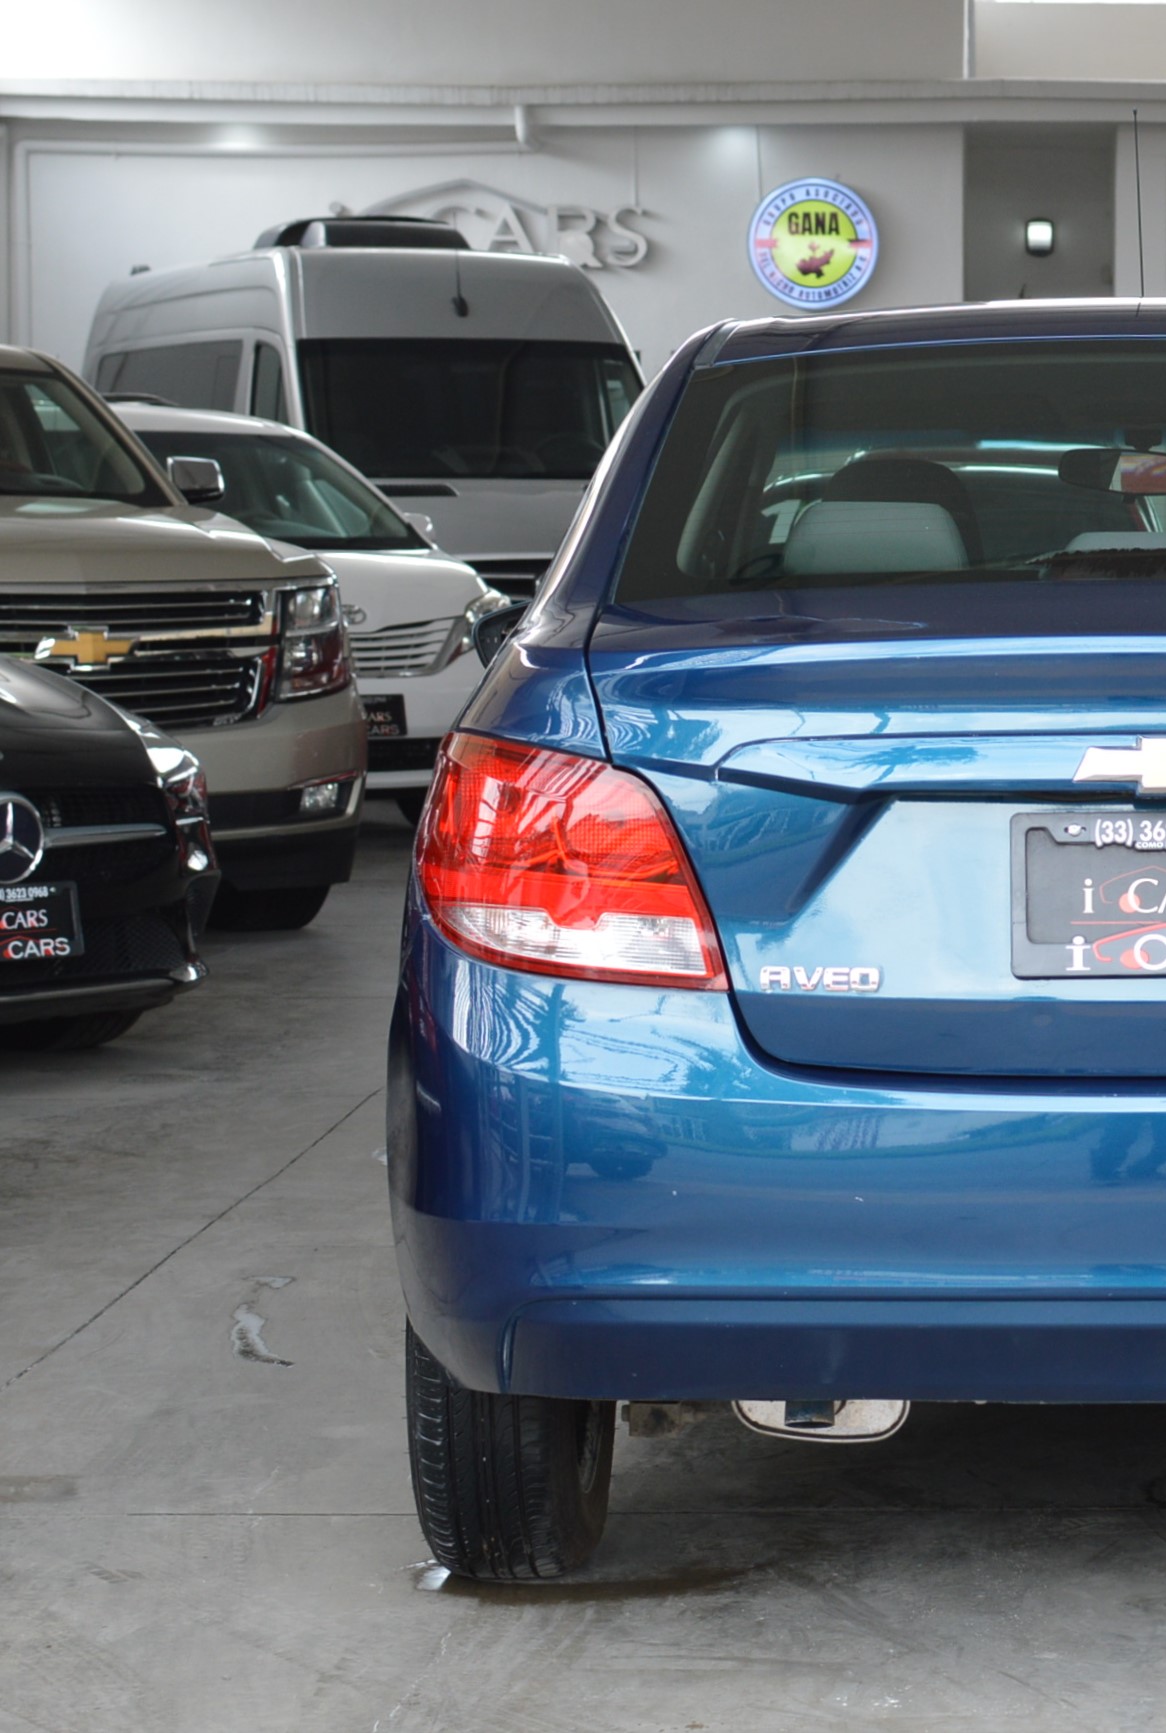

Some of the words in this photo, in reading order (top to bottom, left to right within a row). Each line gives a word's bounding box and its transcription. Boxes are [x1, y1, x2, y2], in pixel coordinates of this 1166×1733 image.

[787, 211, 841, 236] GANA
[1095, 819, 1134, 848] (33)
[1135, 840, 1163, 849] COMO
[1082, 878, 1095, 913] i
[2, 909, 48, 929] CARS
[8, 937, 71, 959] CARS
[1066, 935, 1091, 971] i
[760, 965, 880, 992] AVEO
